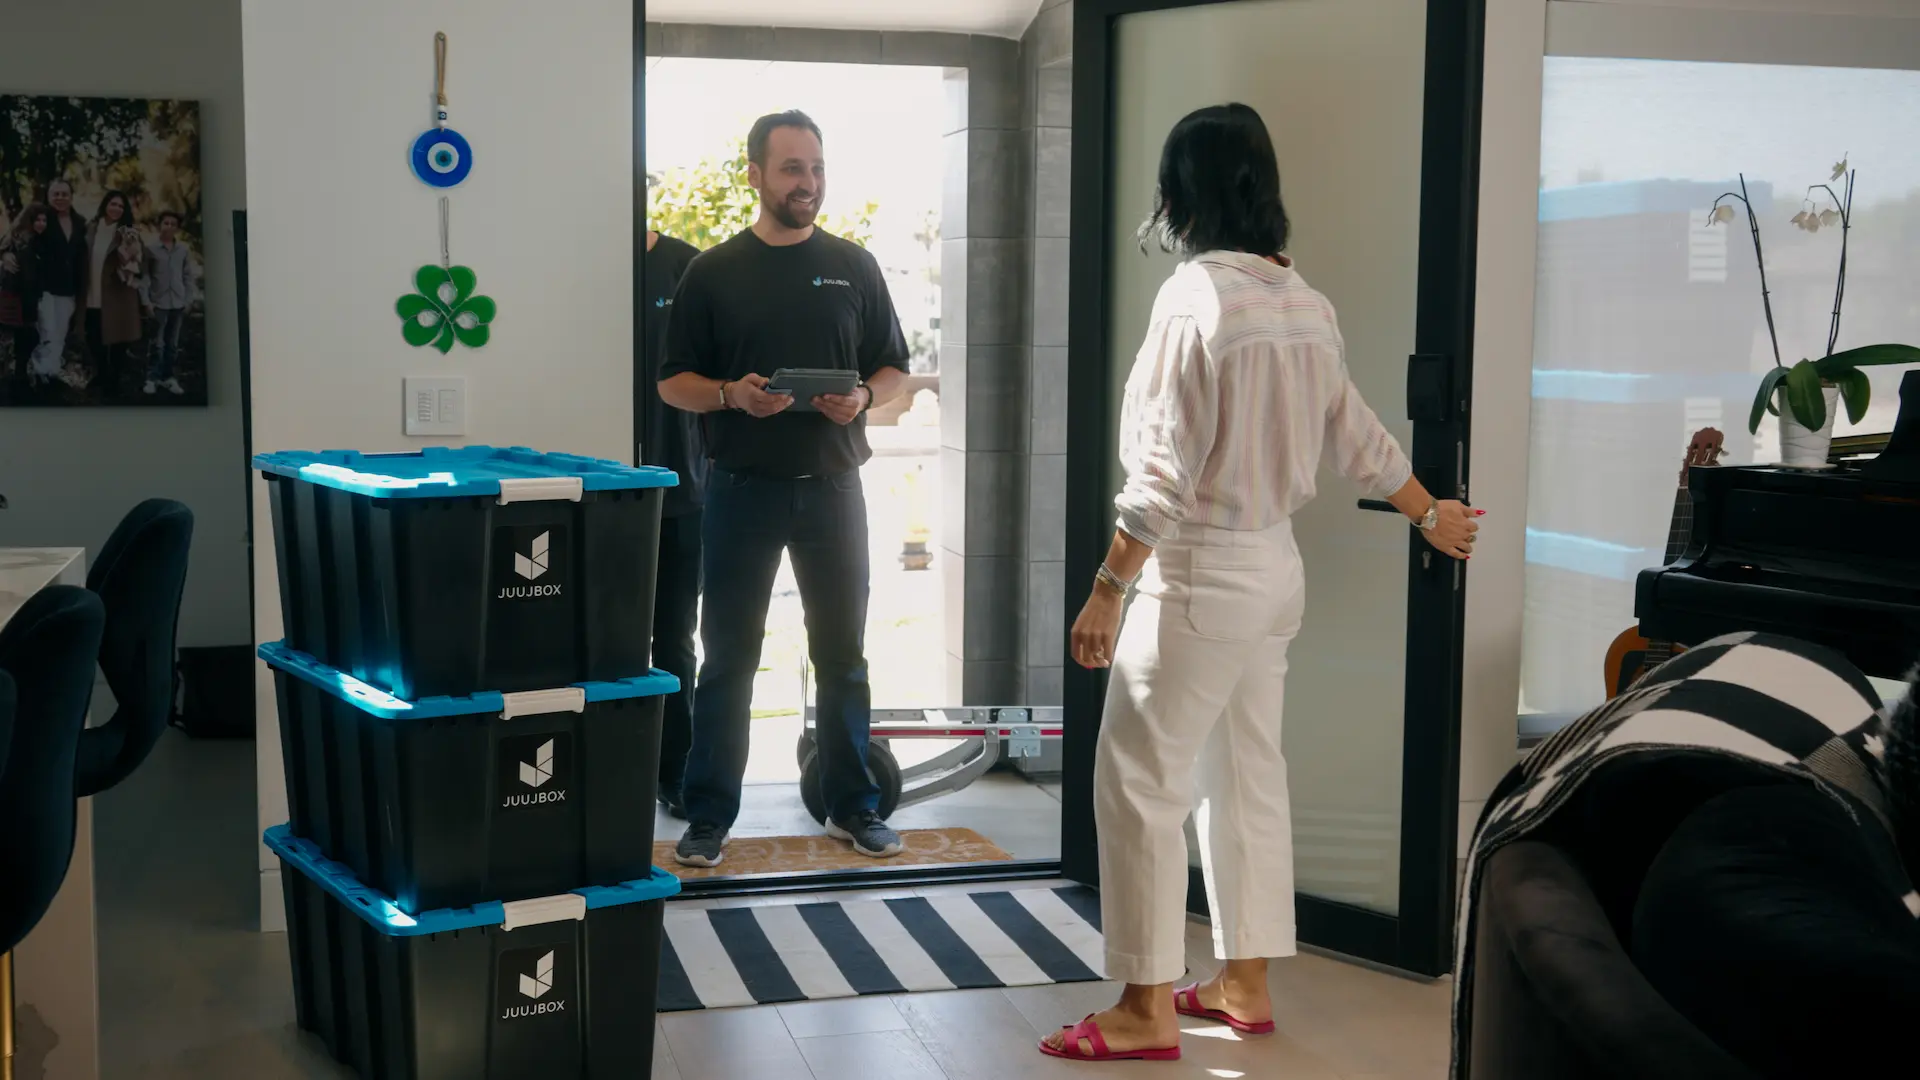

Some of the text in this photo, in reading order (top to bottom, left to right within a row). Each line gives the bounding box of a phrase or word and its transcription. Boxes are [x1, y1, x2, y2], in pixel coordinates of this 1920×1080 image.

[498, 584, 561, 599] JUUJBOX
[502, 789, 566, 808] JUUJBOX
[502, 1000, 565, 1019] JUUJBOX
